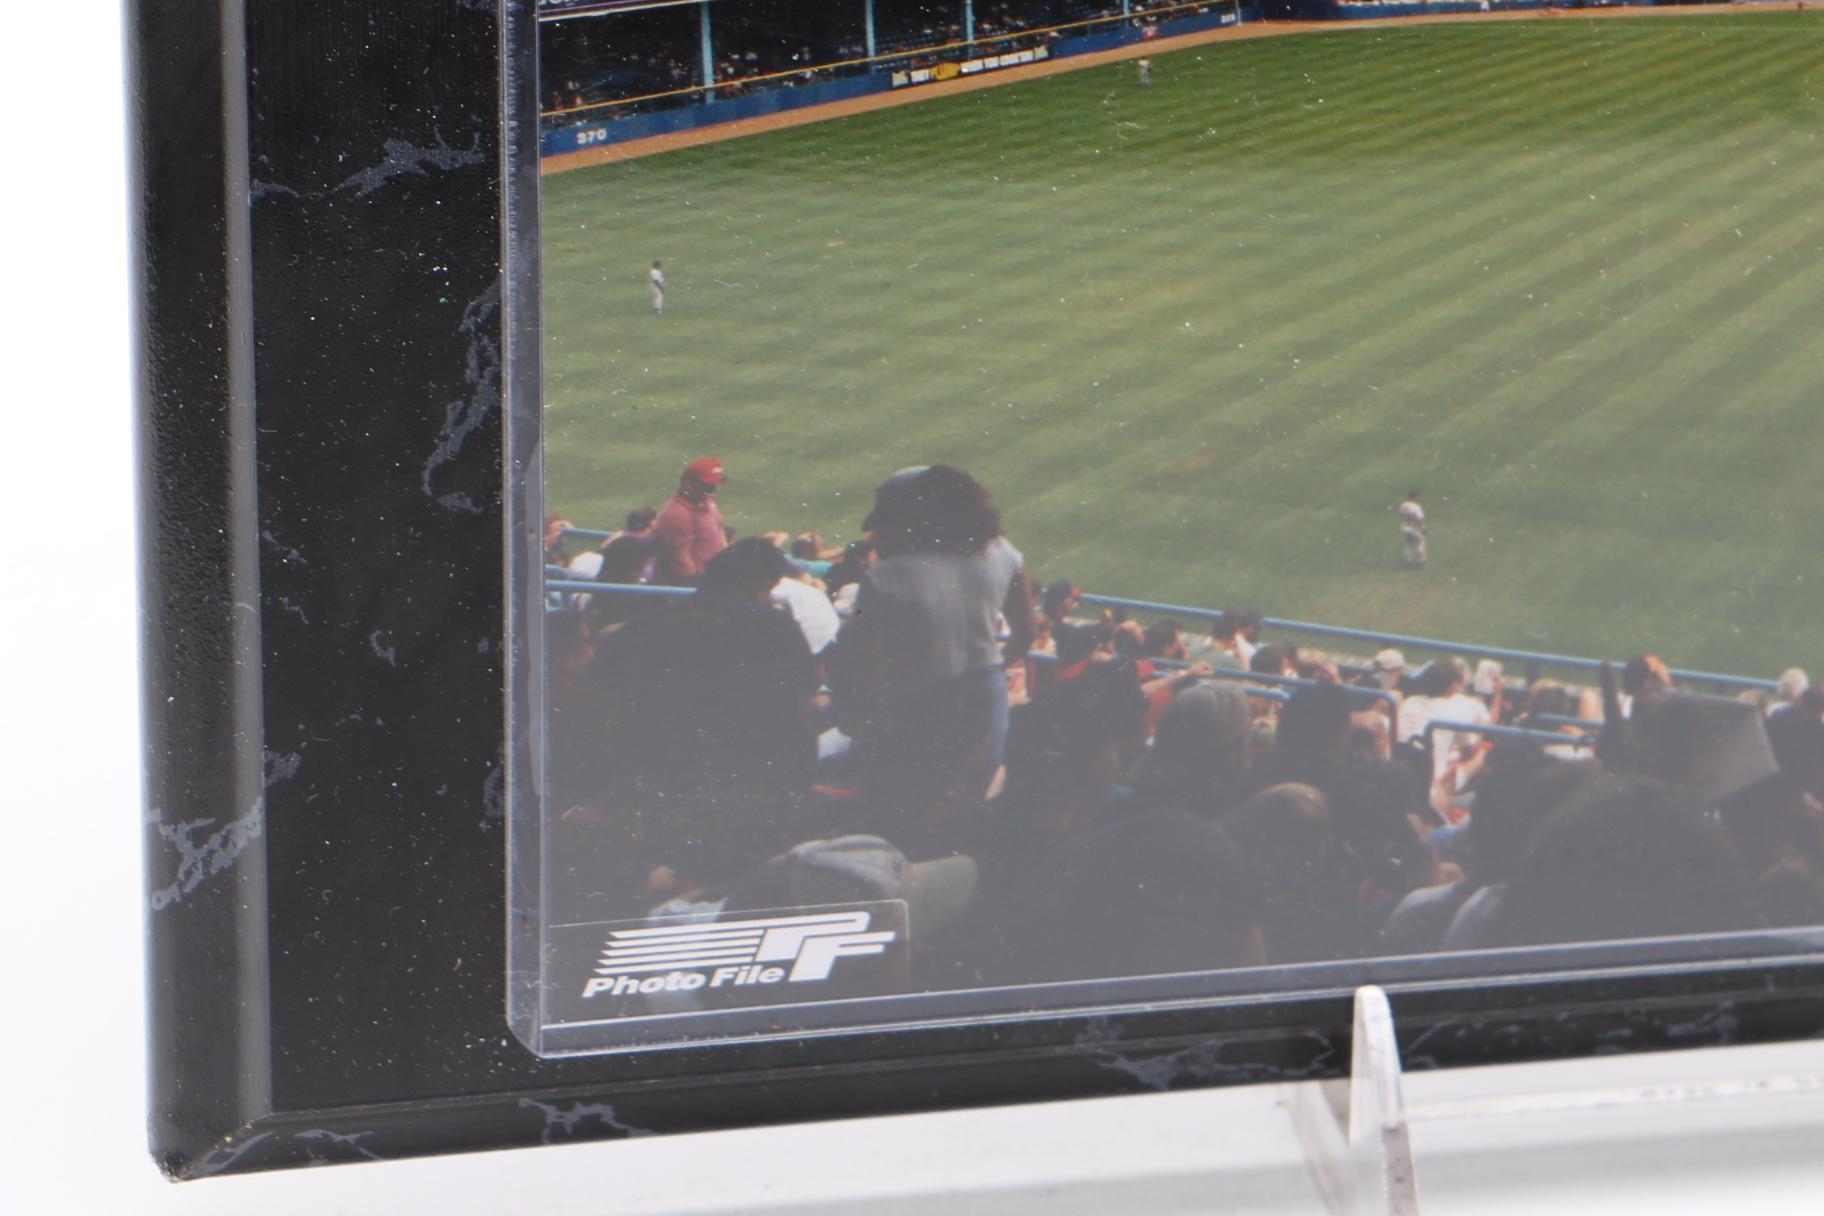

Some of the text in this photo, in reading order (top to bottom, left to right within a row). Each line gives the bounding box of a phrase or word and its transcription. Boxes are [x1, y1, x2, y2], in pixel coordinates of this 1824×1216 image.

[576, 129, 607, 144] 370
[582, 964, 785, 998] Photo File
